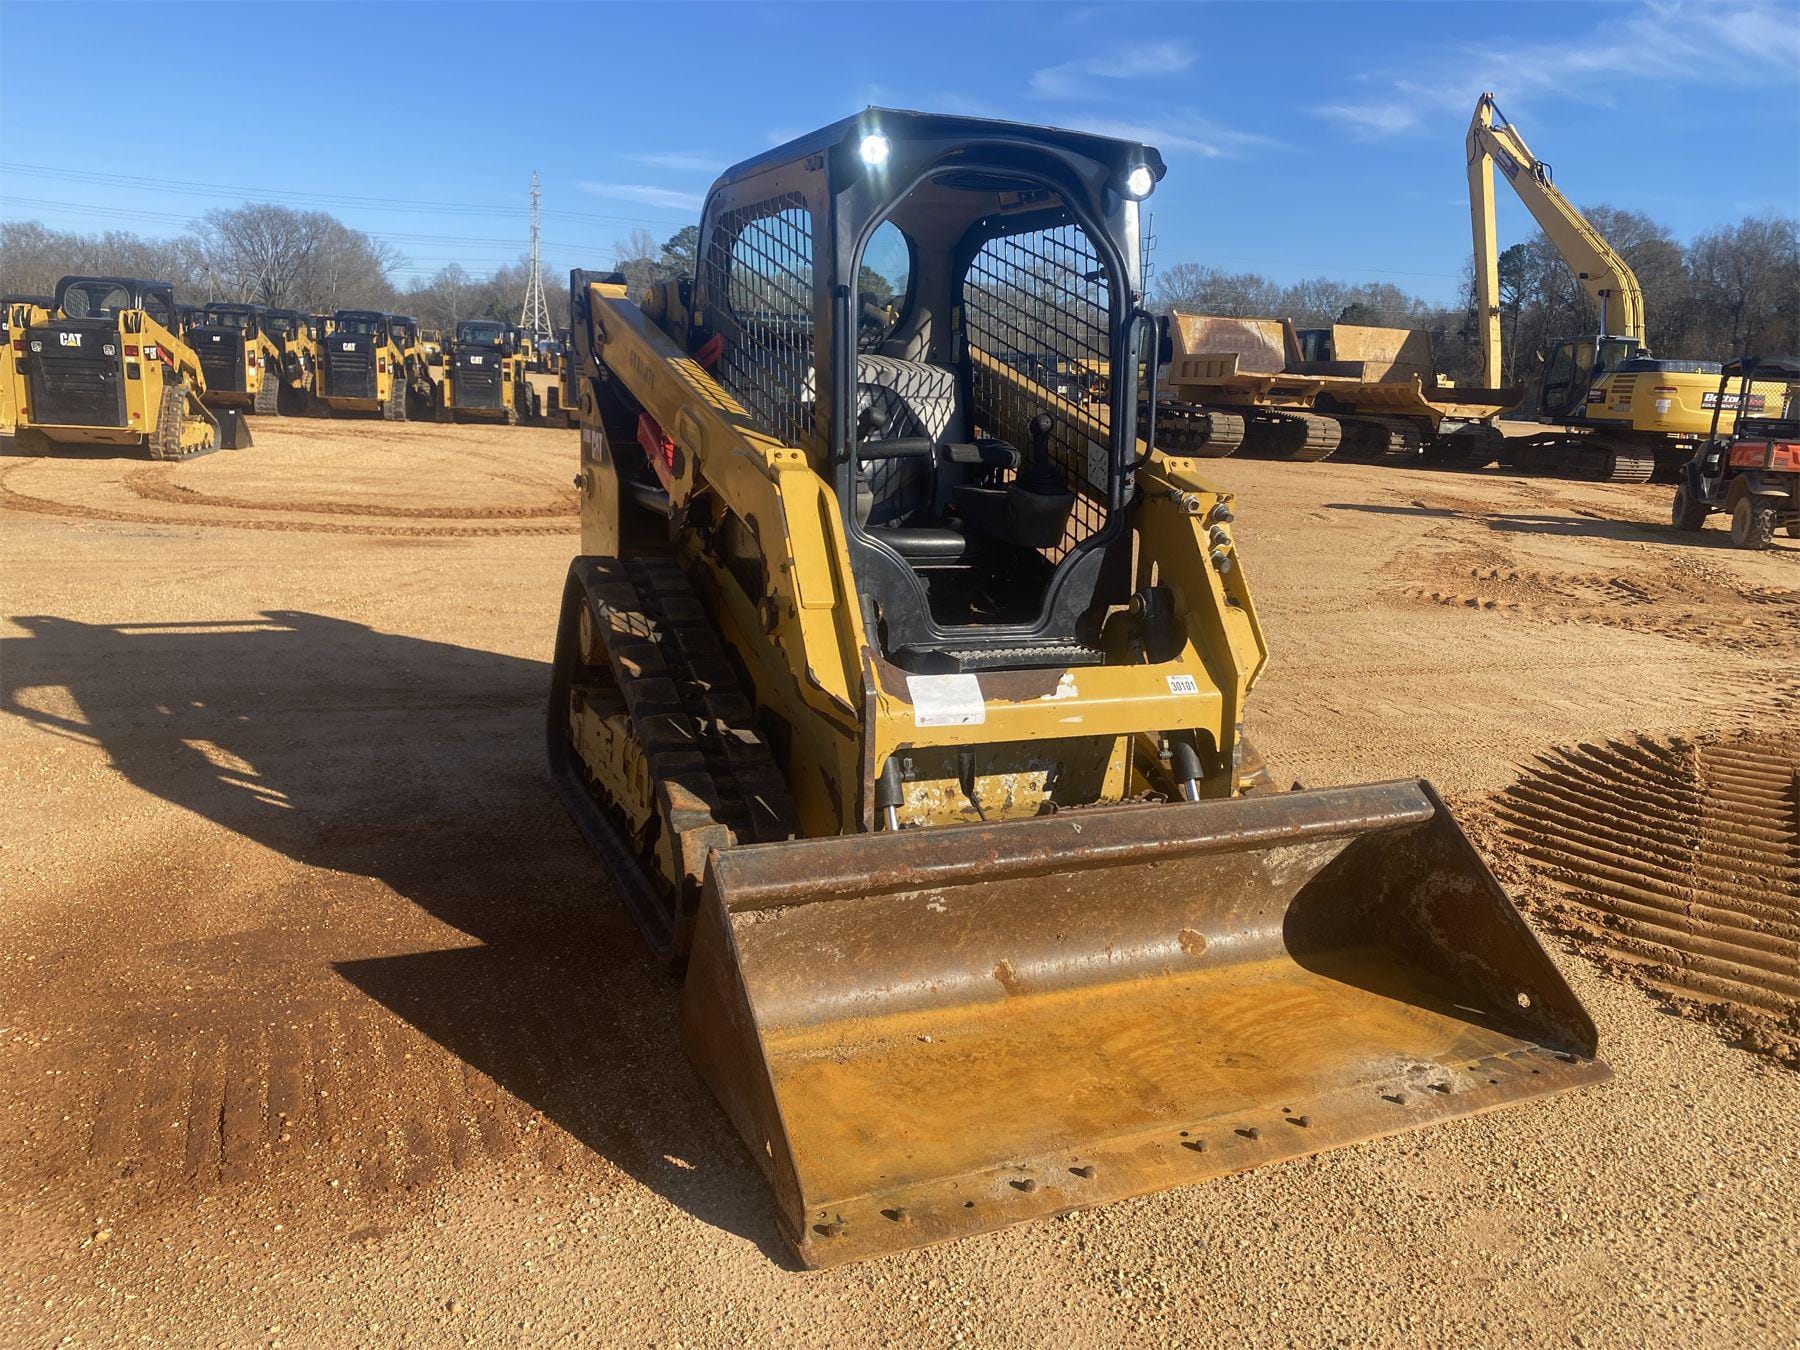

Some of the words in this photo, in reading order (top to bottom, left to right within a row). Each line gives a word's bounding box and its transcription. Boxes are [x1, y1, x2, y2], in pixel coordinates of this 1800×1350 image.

[59, 332, 83, 347] CAT
[342, 342, 356, 352] CAT
[470, 355, 483, 365] CAT
[1171, 681, 1196, 692] 30101
